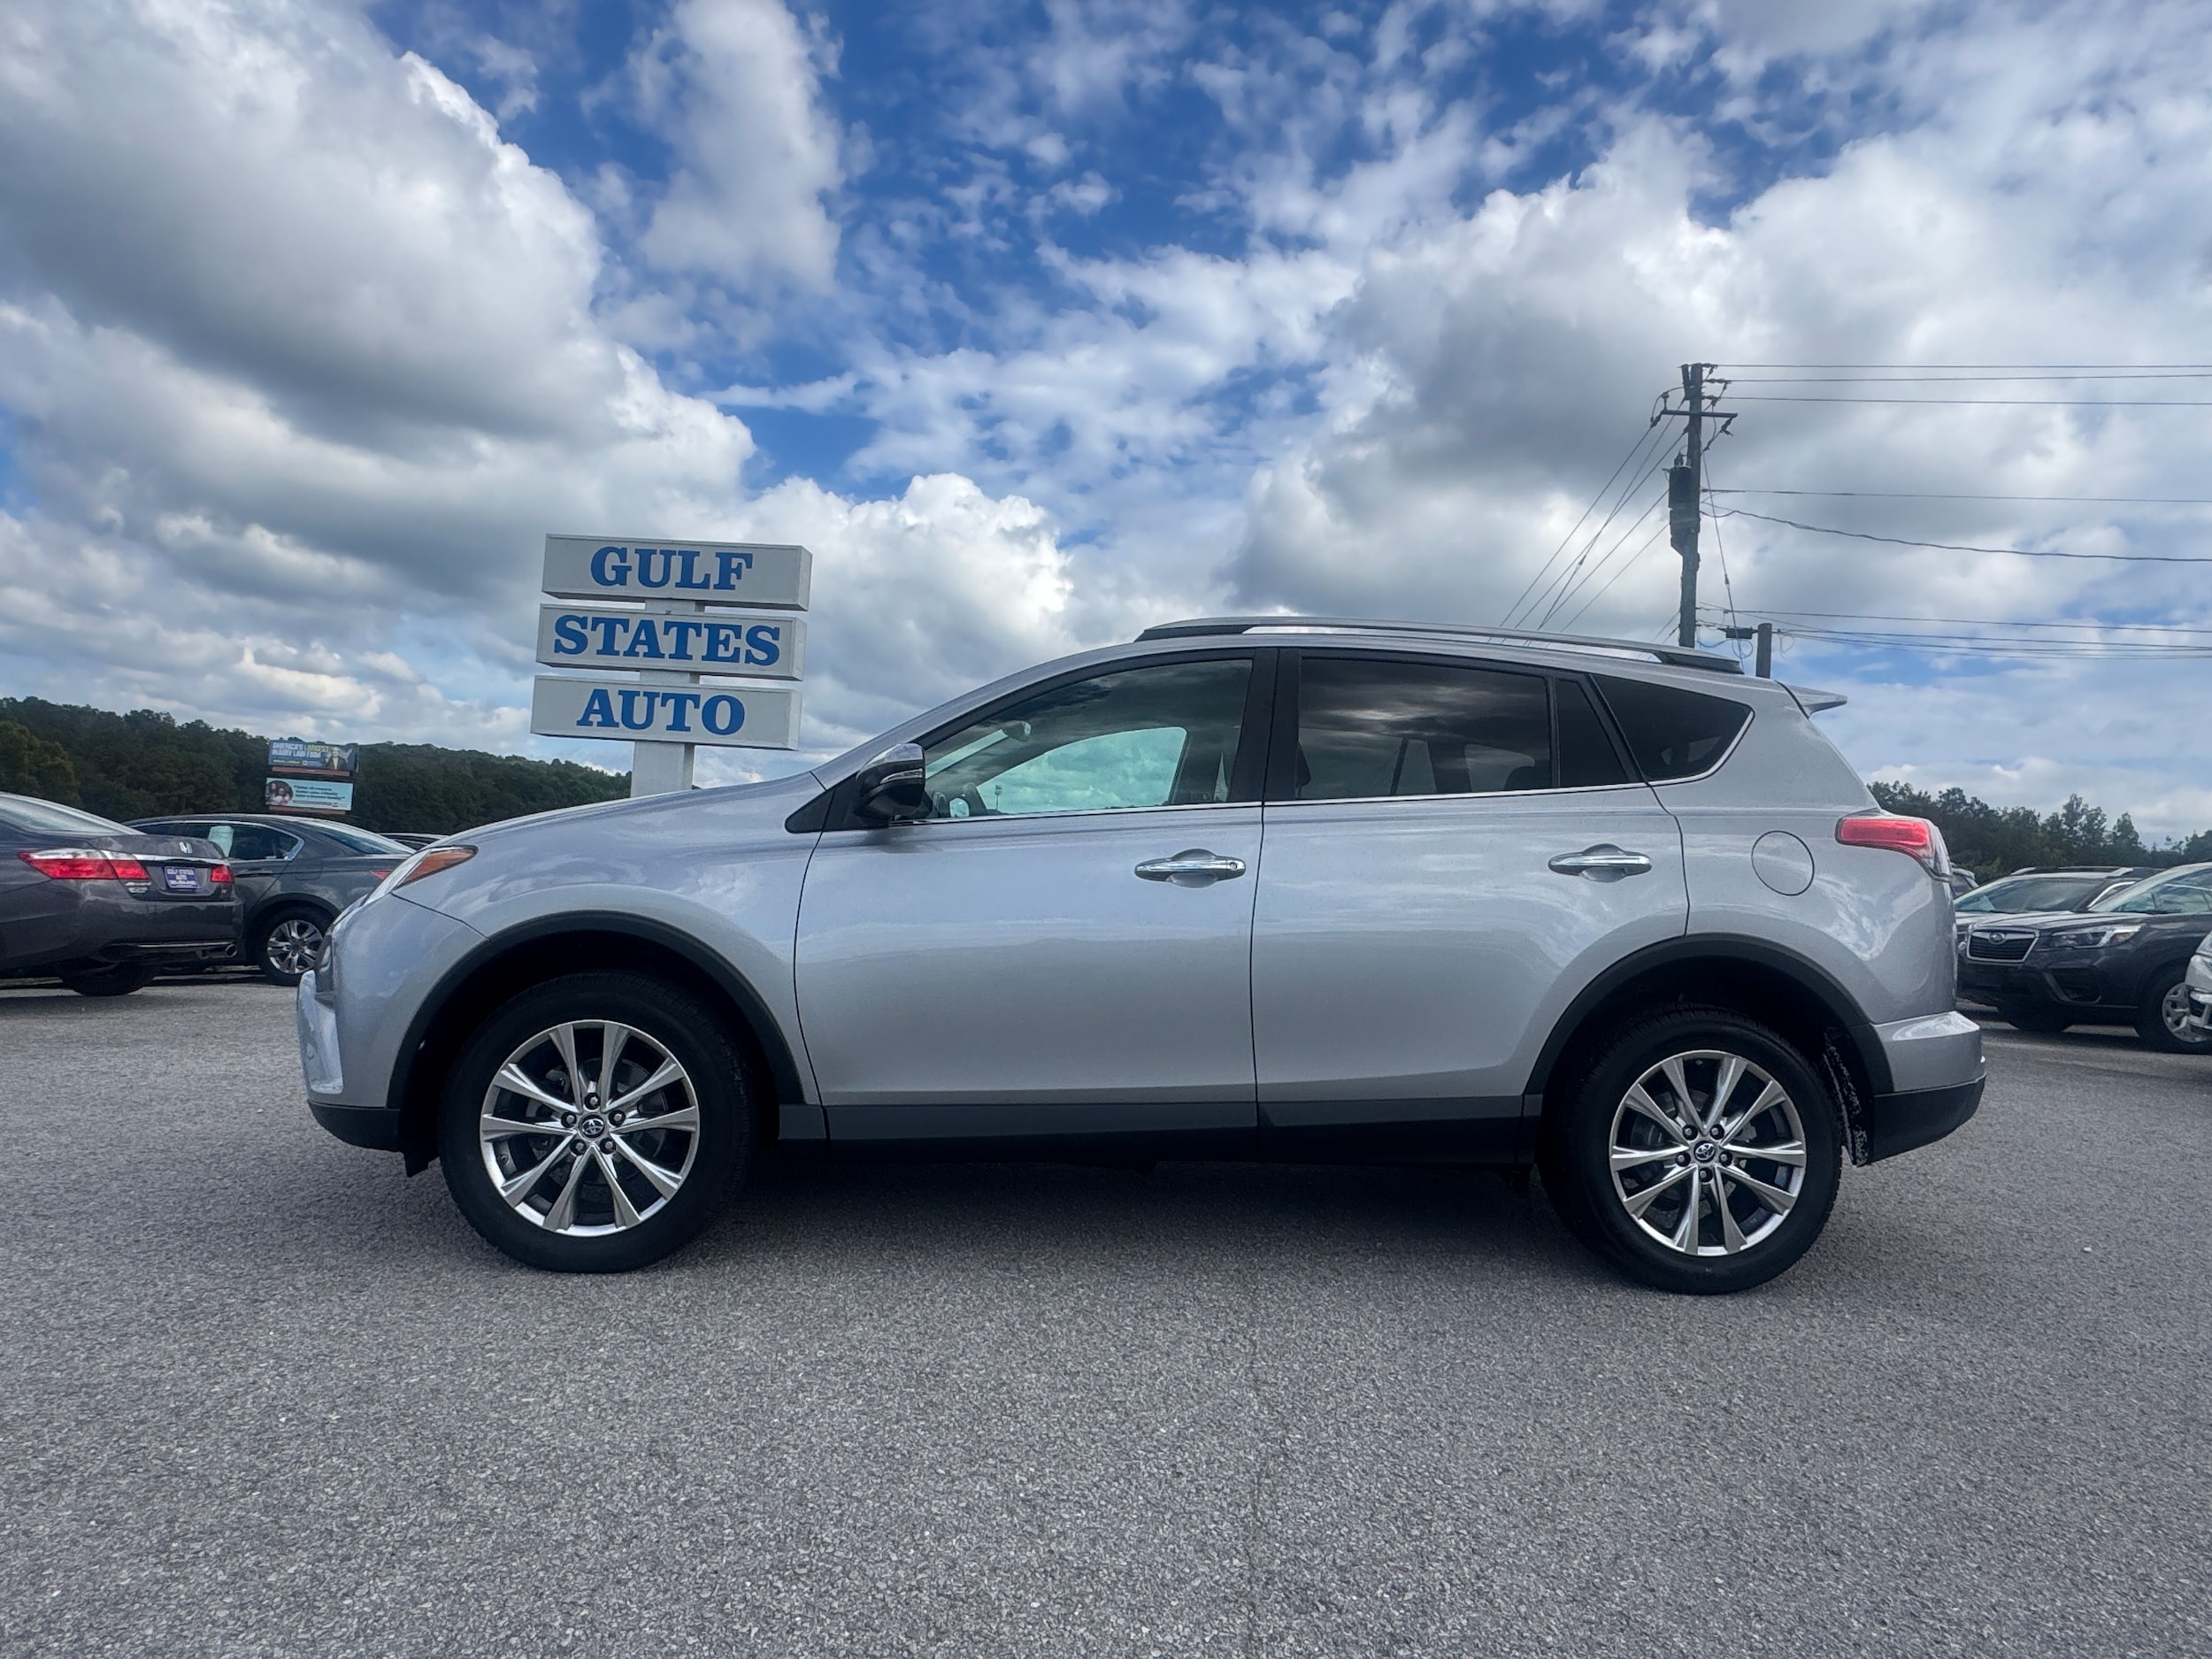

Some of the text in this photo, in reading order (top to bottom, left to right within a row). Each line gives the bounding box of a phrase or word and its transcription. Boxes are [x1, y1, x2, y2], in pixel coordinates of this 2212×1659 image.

[590, 546, 753, 591] GULF
[554, 614, 780, 666] STATES
[576, 688, 745, 736] AUTO
